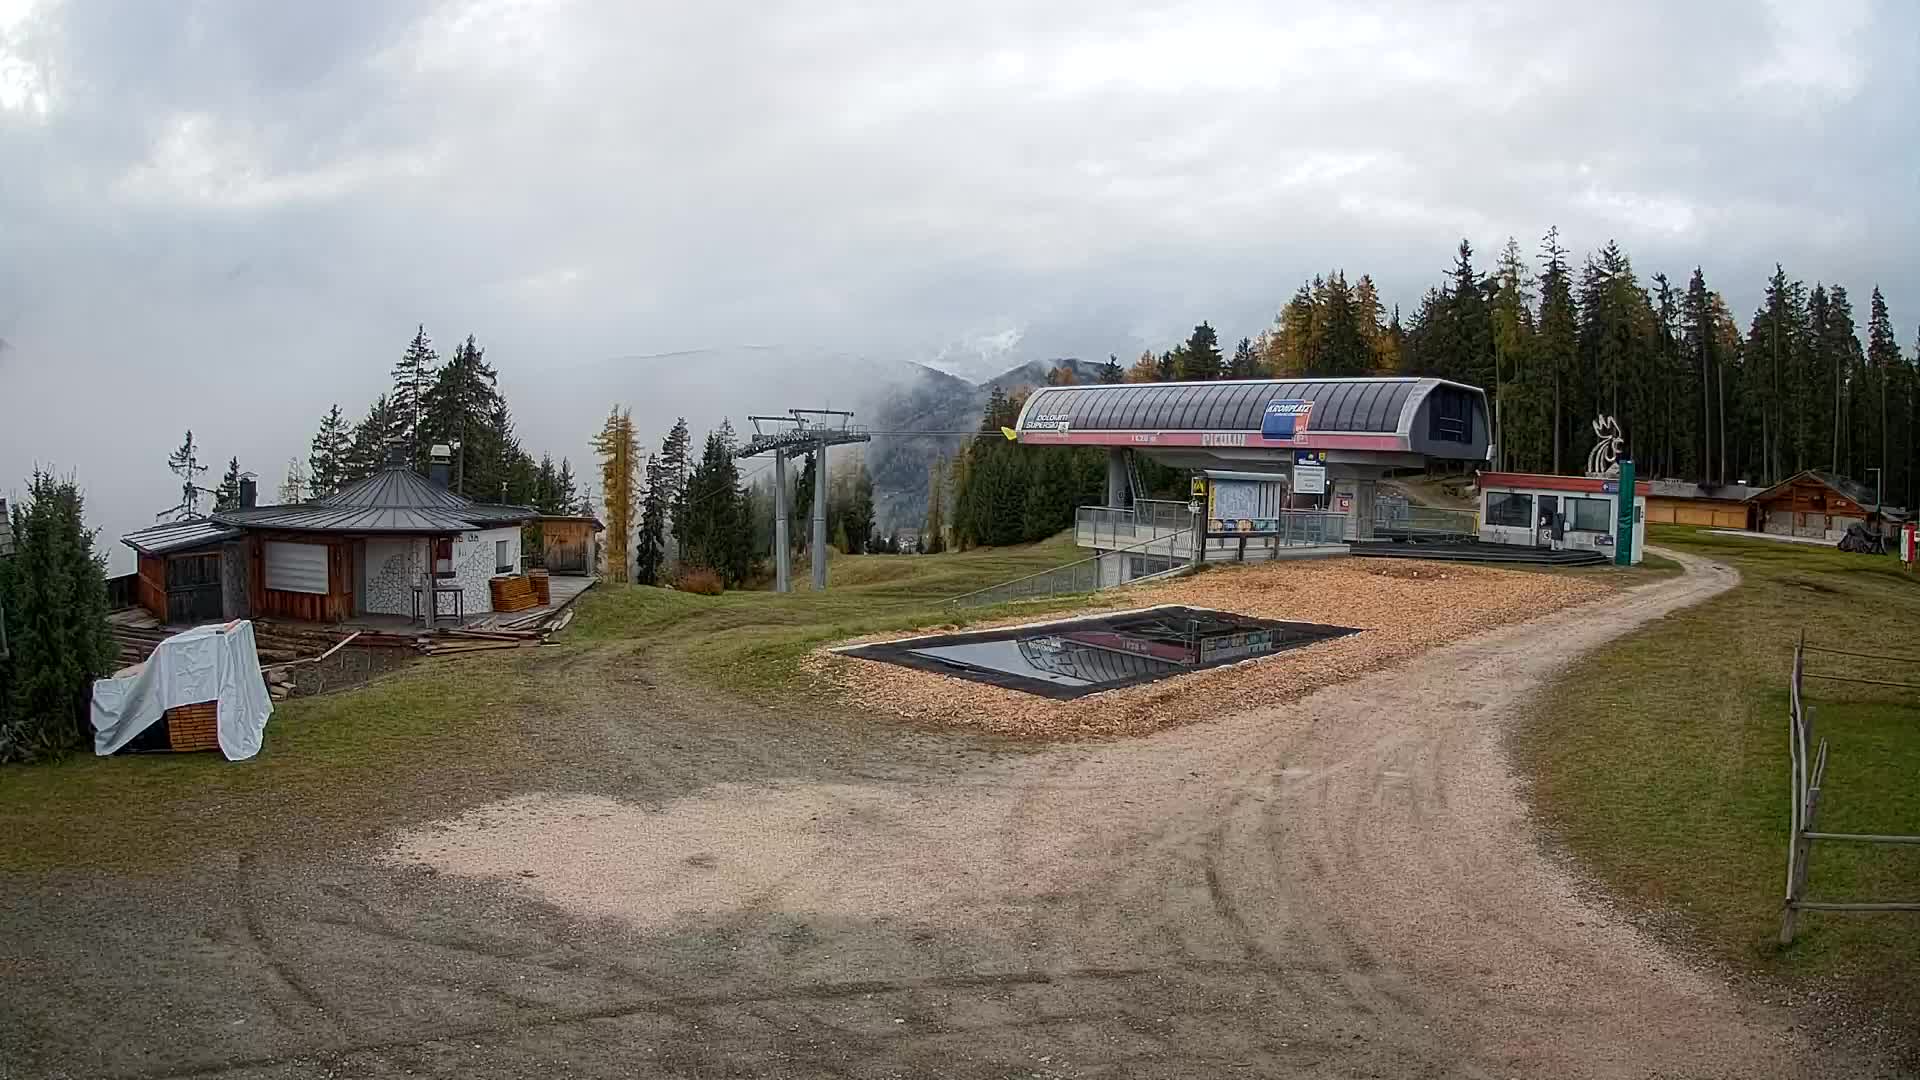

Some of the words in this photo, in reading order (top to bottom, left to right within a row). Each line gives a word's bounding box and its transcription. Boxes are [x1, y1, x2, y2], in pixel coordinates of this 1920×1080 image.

[1265, 404, 1311, 413] KRONPLATZ
[1025, 421, 1059, 429] SUPERSKI
[1202, 433, 1246, 447] PICULIN
